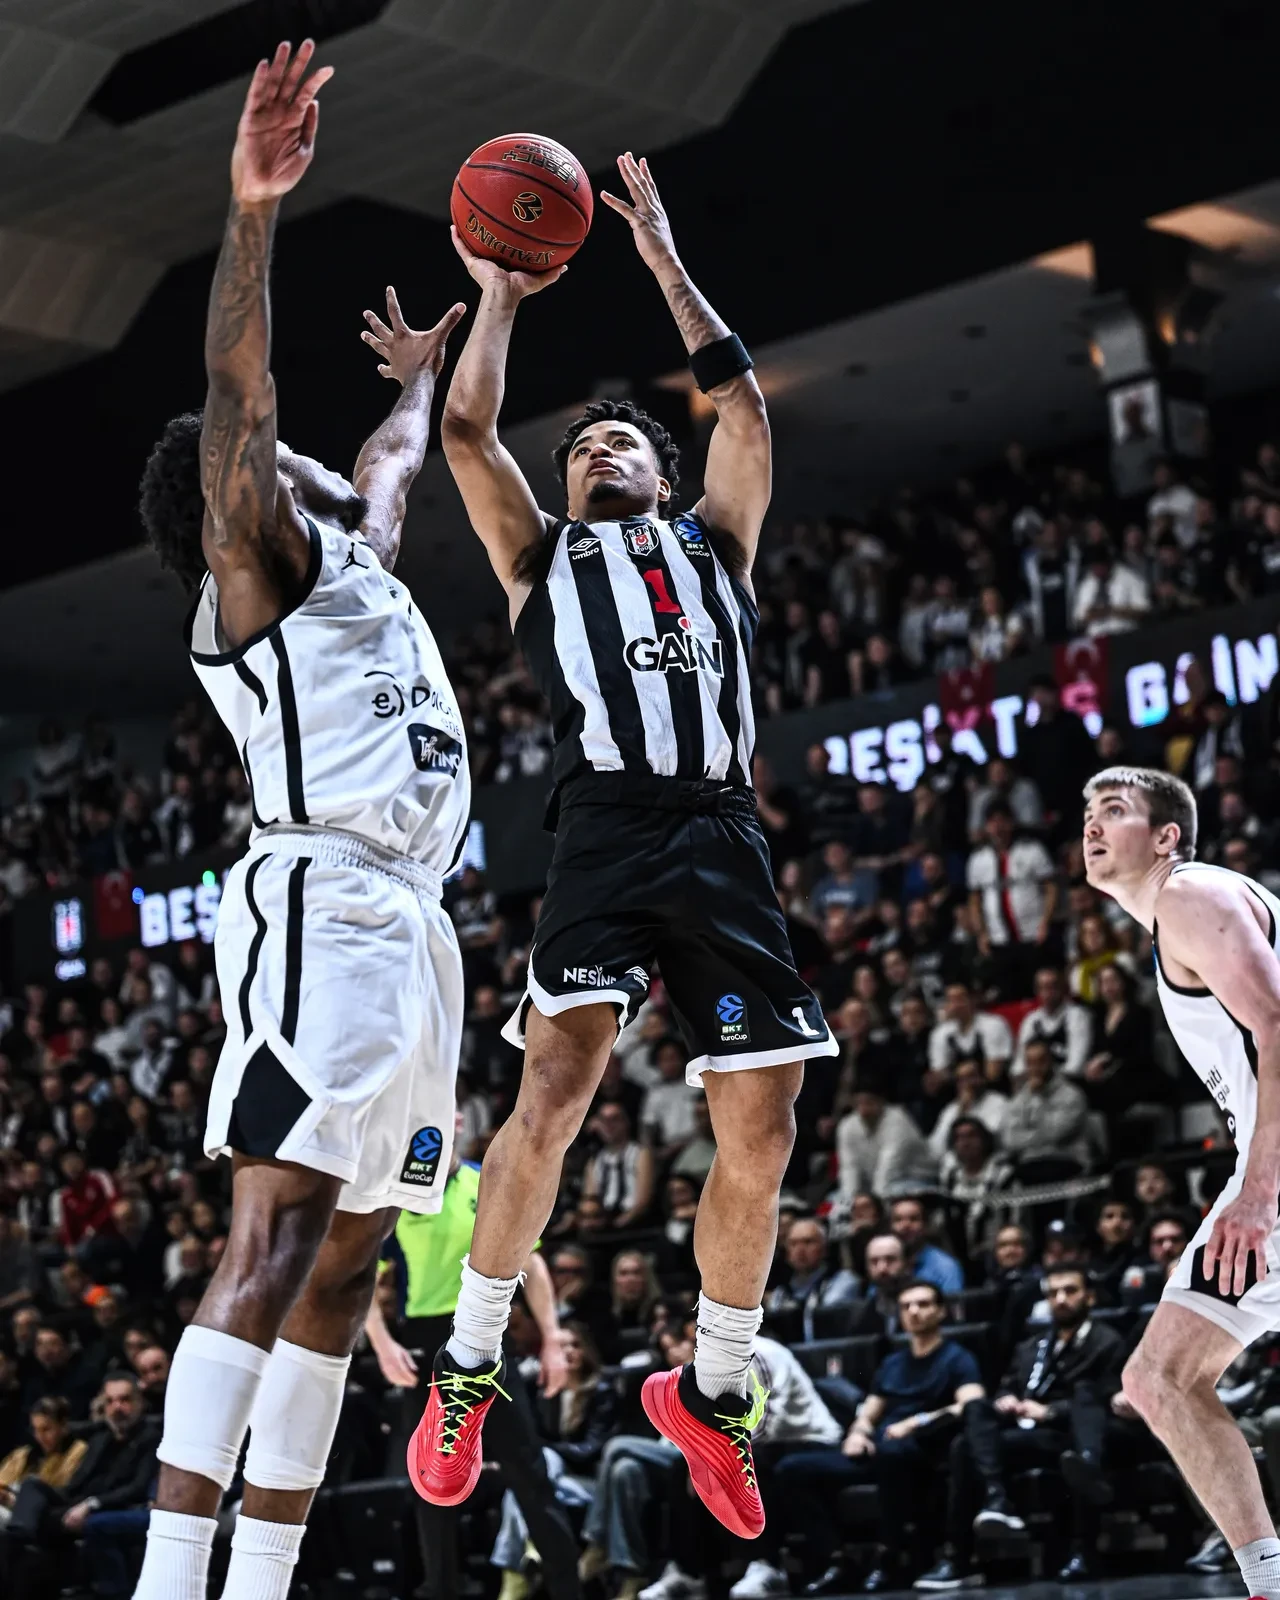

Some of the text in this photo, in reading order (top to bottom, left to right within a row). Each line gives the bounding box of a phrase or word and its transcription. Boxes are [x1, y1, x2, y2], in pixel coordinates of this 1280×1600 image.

[466, 213, 556, 265] SPALDING
[572, 547, 600, 560] umbro
[643, 569, 681, 614] 1
[792, 1006, 820, 1037] 1
[722, 1025, 742, 1033] BKT
[409, 1161, 433, 1171] BKT
[403, 1171, 433, 1183] EuroCup
